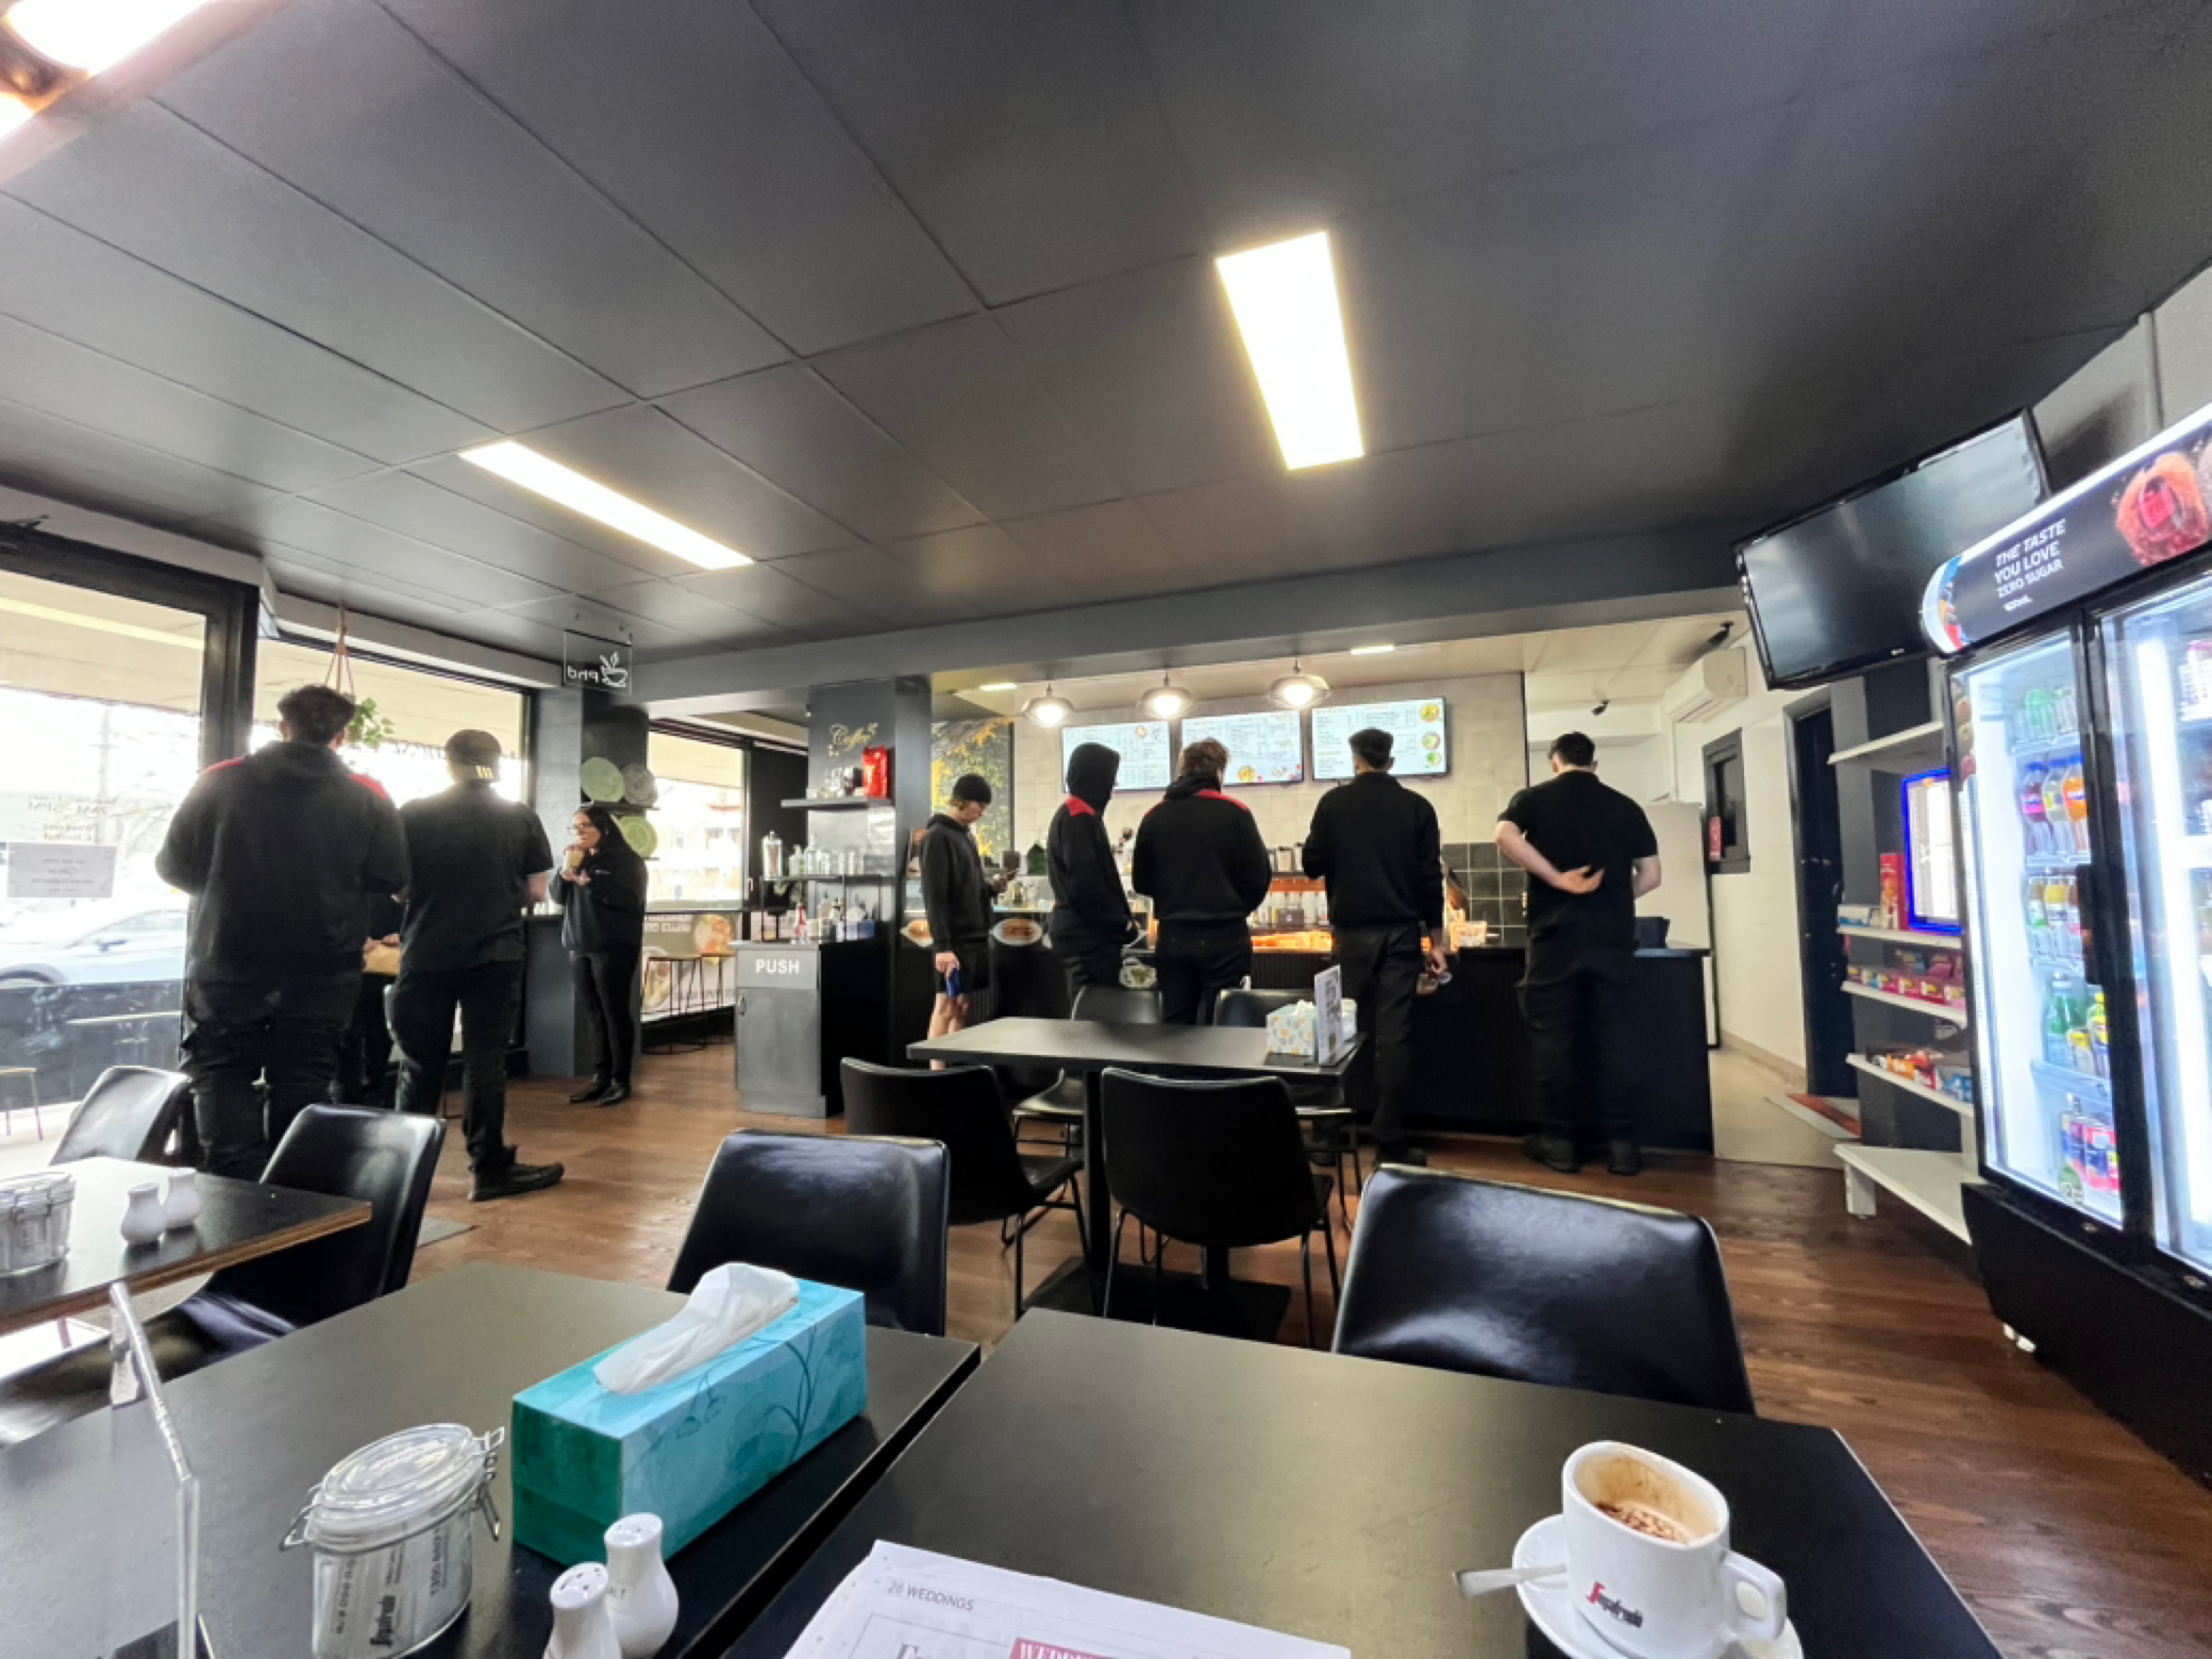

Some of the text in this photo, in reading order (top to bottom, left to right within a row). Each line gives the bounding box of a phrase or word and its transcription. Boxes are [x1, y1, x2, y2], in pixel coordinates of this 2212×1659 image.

[1995, 540, 2060, 584] YOU LOVE
[1997, 518, 2066, 567] THE TASTE
[1997, 559, 2064, 598] ZERO SUGAR
[755, 958, 800, 975] PUSH
[907, 1583, 974, 1611] WEDDINGS
